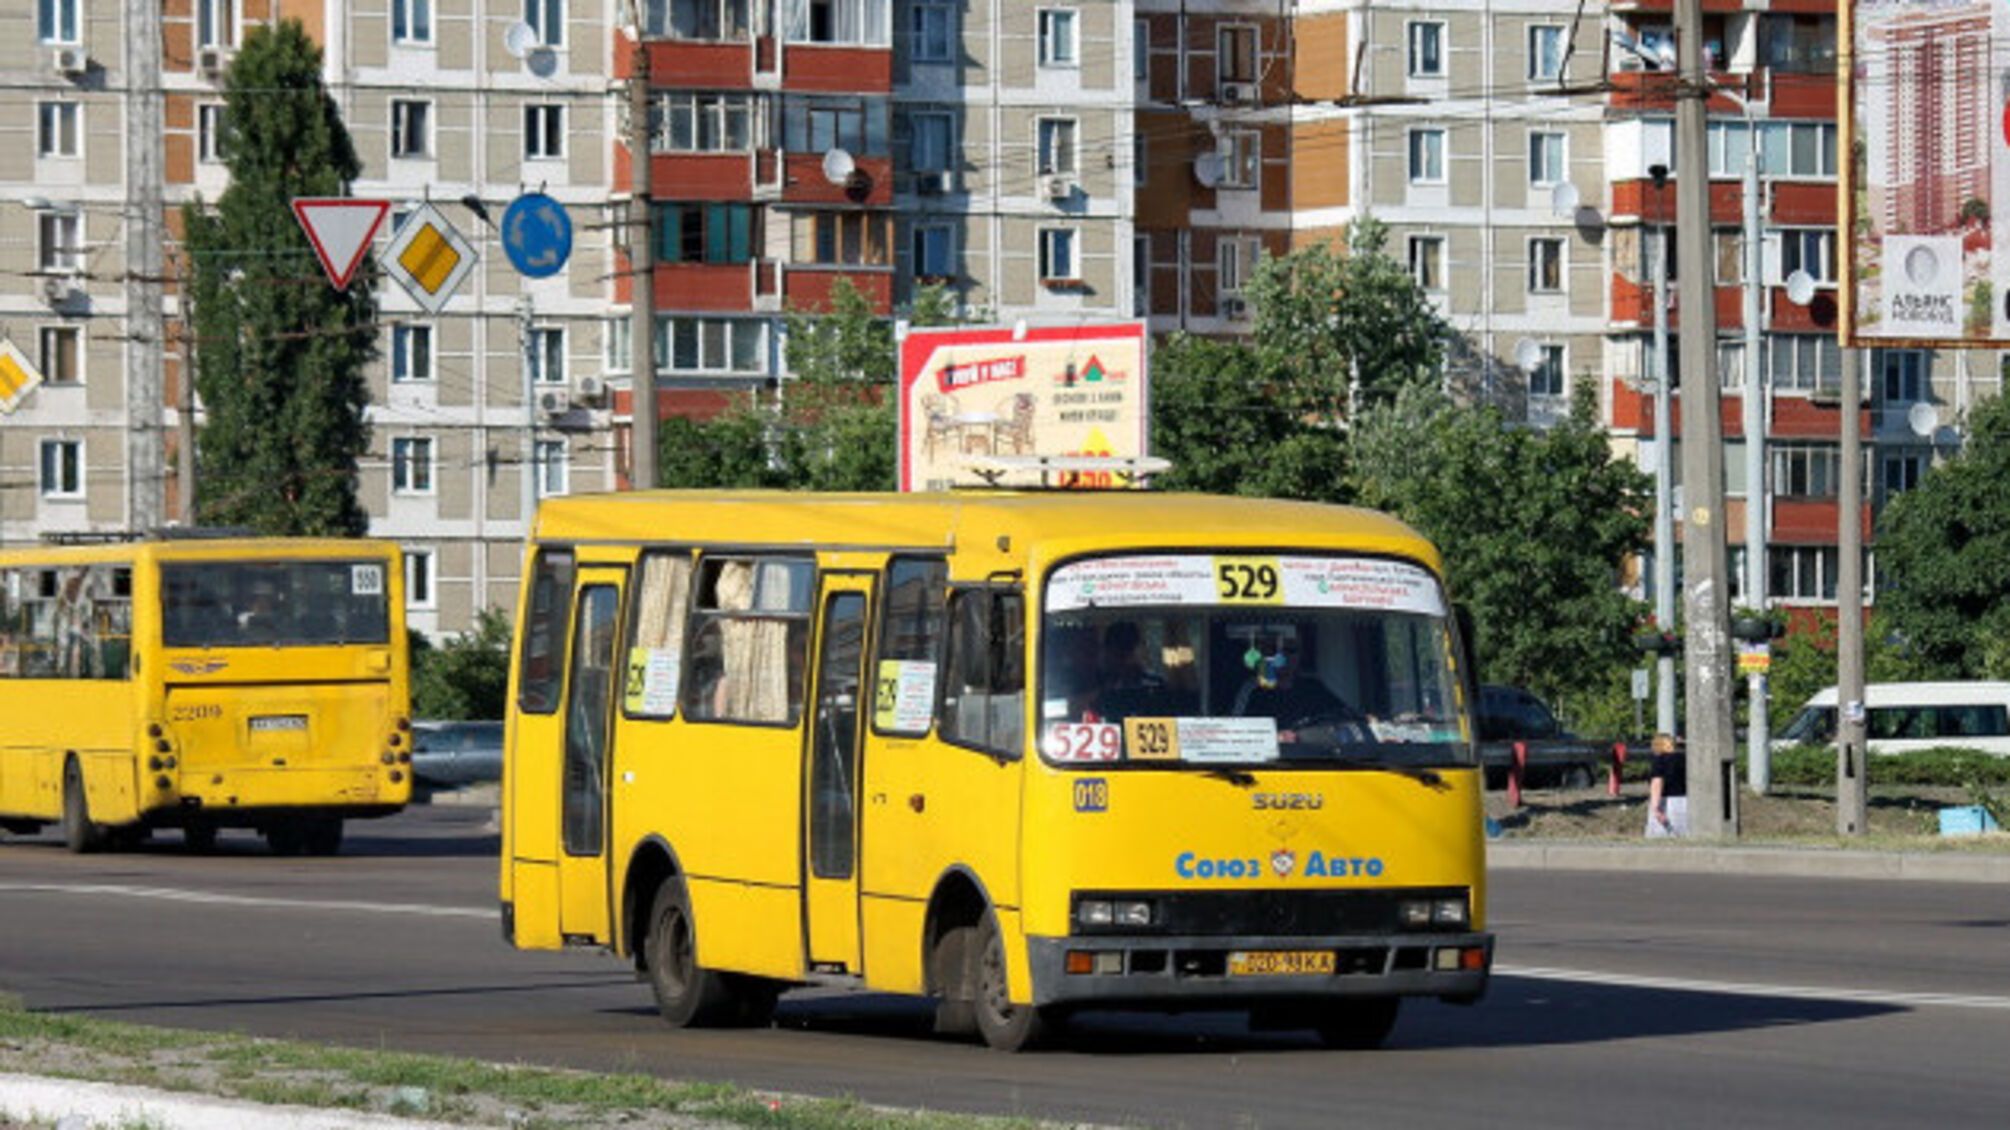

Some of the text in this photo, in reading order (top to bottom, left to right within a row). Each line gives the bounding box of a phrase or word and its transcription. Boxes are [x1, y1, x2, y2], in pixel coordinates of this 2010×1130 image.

[1219, 564, 1278, 598] 529
[173, 704, 223, 721] 2209
[1052, 724, 1121, 759] 529
[1137, 723, 1170, 754] 529
[1074, 782, 1106, 808] 018
